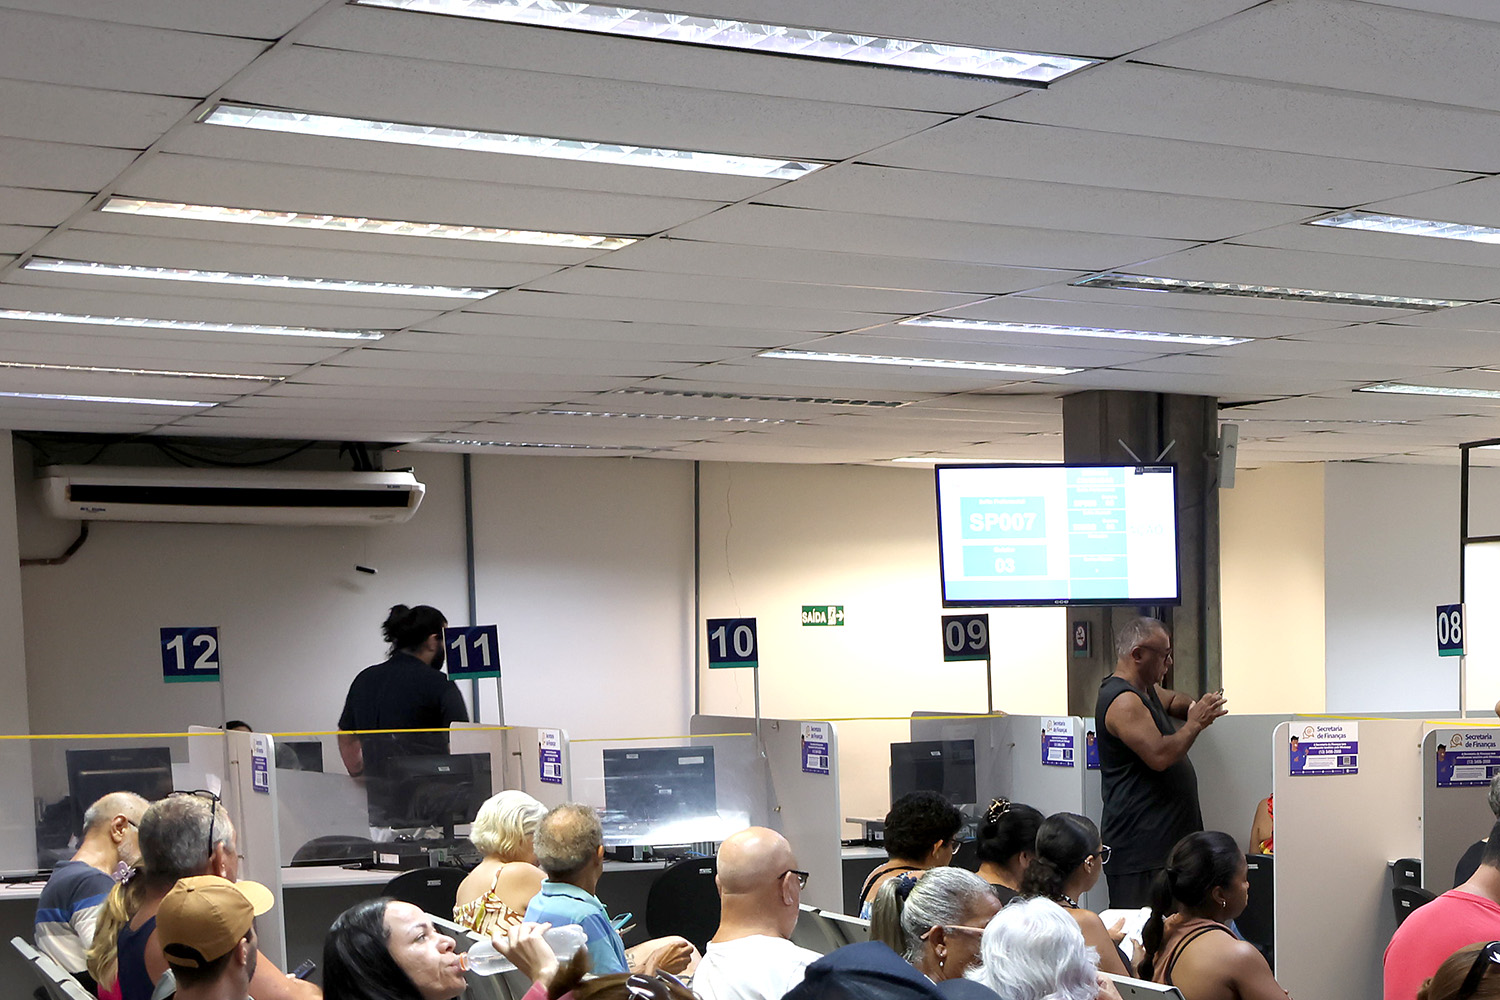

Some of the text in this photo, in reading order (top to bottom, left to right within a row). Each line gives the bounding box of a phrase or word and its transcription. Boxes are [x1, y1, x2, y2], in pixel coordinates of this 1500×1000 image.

[970, 513, 1037, 532] SP007
[995, 558, 1015, 573] 03
[803, 608, 826, 623] SAÍDA
[1439, 611, 1461, 644] 08
[452, 633, 490, 667] 11
[712, 626, 753, 657] 10
[946, 620, 987, 651] 09
[167, 635, 218, 669] 12
